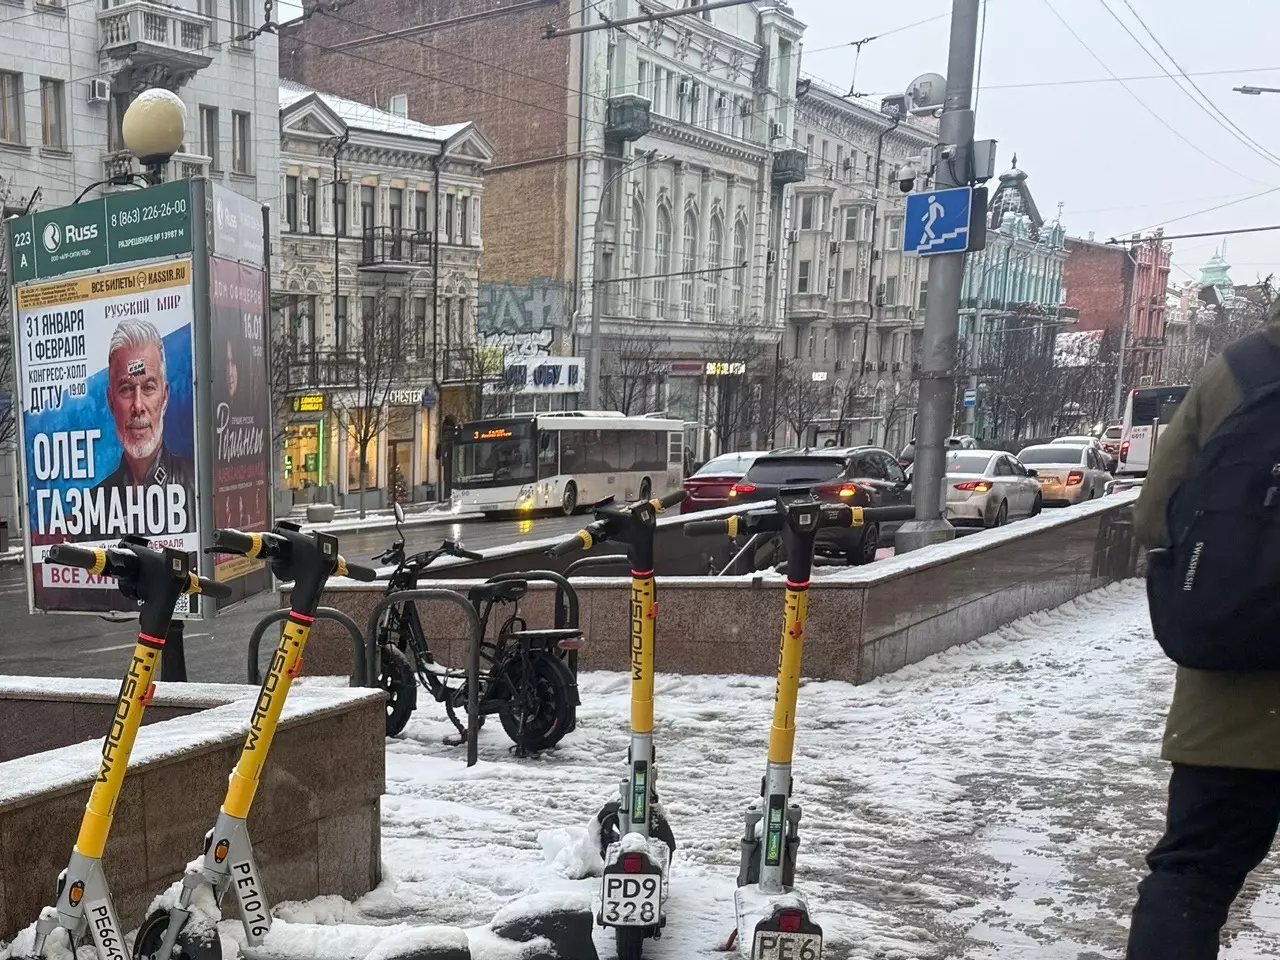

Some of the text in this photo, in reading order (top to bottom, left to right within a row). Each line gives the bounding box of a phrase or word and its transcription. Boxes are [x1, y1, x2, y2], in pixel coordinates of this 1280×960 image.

[112, 199, 186, 227] 8 (863) 226-26-00
[14, 231, 31, 247] 223
[66, 224, 98, 243] Russ
[118, 236, 153, 248] РАЗРЕШЕНИЕ
[92, 267, 185, 293] ВСЕ БИЛЕТЫ KASSIR.RU
[105, 295, 181, 319] РУССКИЙ МИР
[26, 309, 84, 338] 31 ЯНВАРЯ
[244, 312, 262, 340] 16.01
[28, 335, 85, 361] 1 ФЕВРАЛЯ
[28, 364, 87, 384] КОНГРЕСС-ХОЛЛ
[30, 384, 62, 413] ДГТУ
[70, 382, 86, 396] 19:00
[389, 390, 422, 403] CHESTER
[34, 429, 101, 480] ОЛЕГ
[36, 484, 187, 535] ГАЗМАНОВ
[149, 539, 184, 549] ФЕВРАЛЯ
[51, 568, 80, 583] ВСЕ
[86, 572, 118, 584] ХИТ
[632, 588, 642, 681] WHOOSH
[245, 634, 292, 750] WHOOSH
[97, 656, 144, 783] WHOOSH
[233, 863, 269, 936] PE1016
[607, 878, 657, 899] PD9
[606, 901, 655, 922] 328
